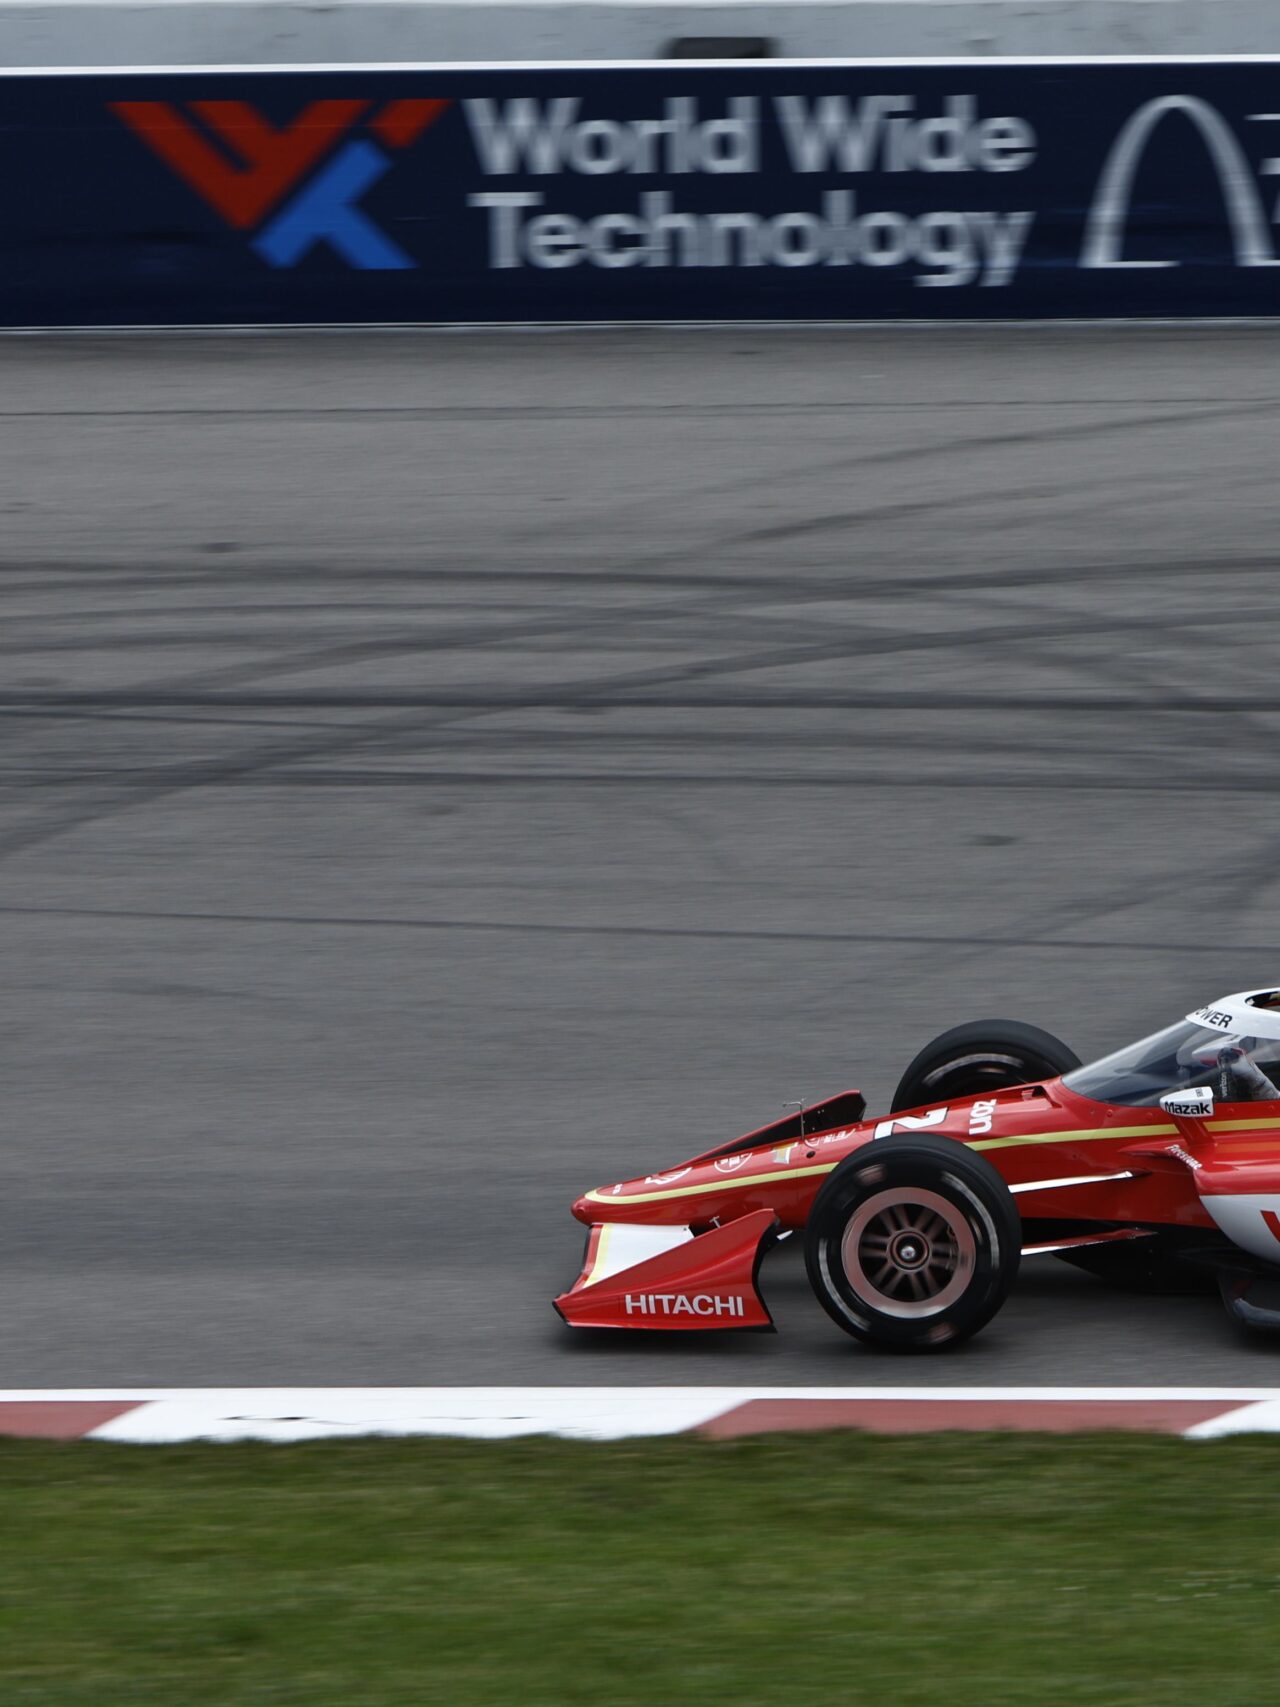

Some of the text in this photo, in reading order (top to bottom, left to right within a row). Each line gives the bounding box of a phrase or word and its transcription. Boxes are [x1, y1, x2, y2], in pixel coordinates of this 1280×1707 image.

[463, 95, 1037, 175] World Wide
[468, 191, 1035, 287] Technology
[1164, 1101, 1211, 1115] Mazak
[625, 1295, 744, 1317] HITACHI
